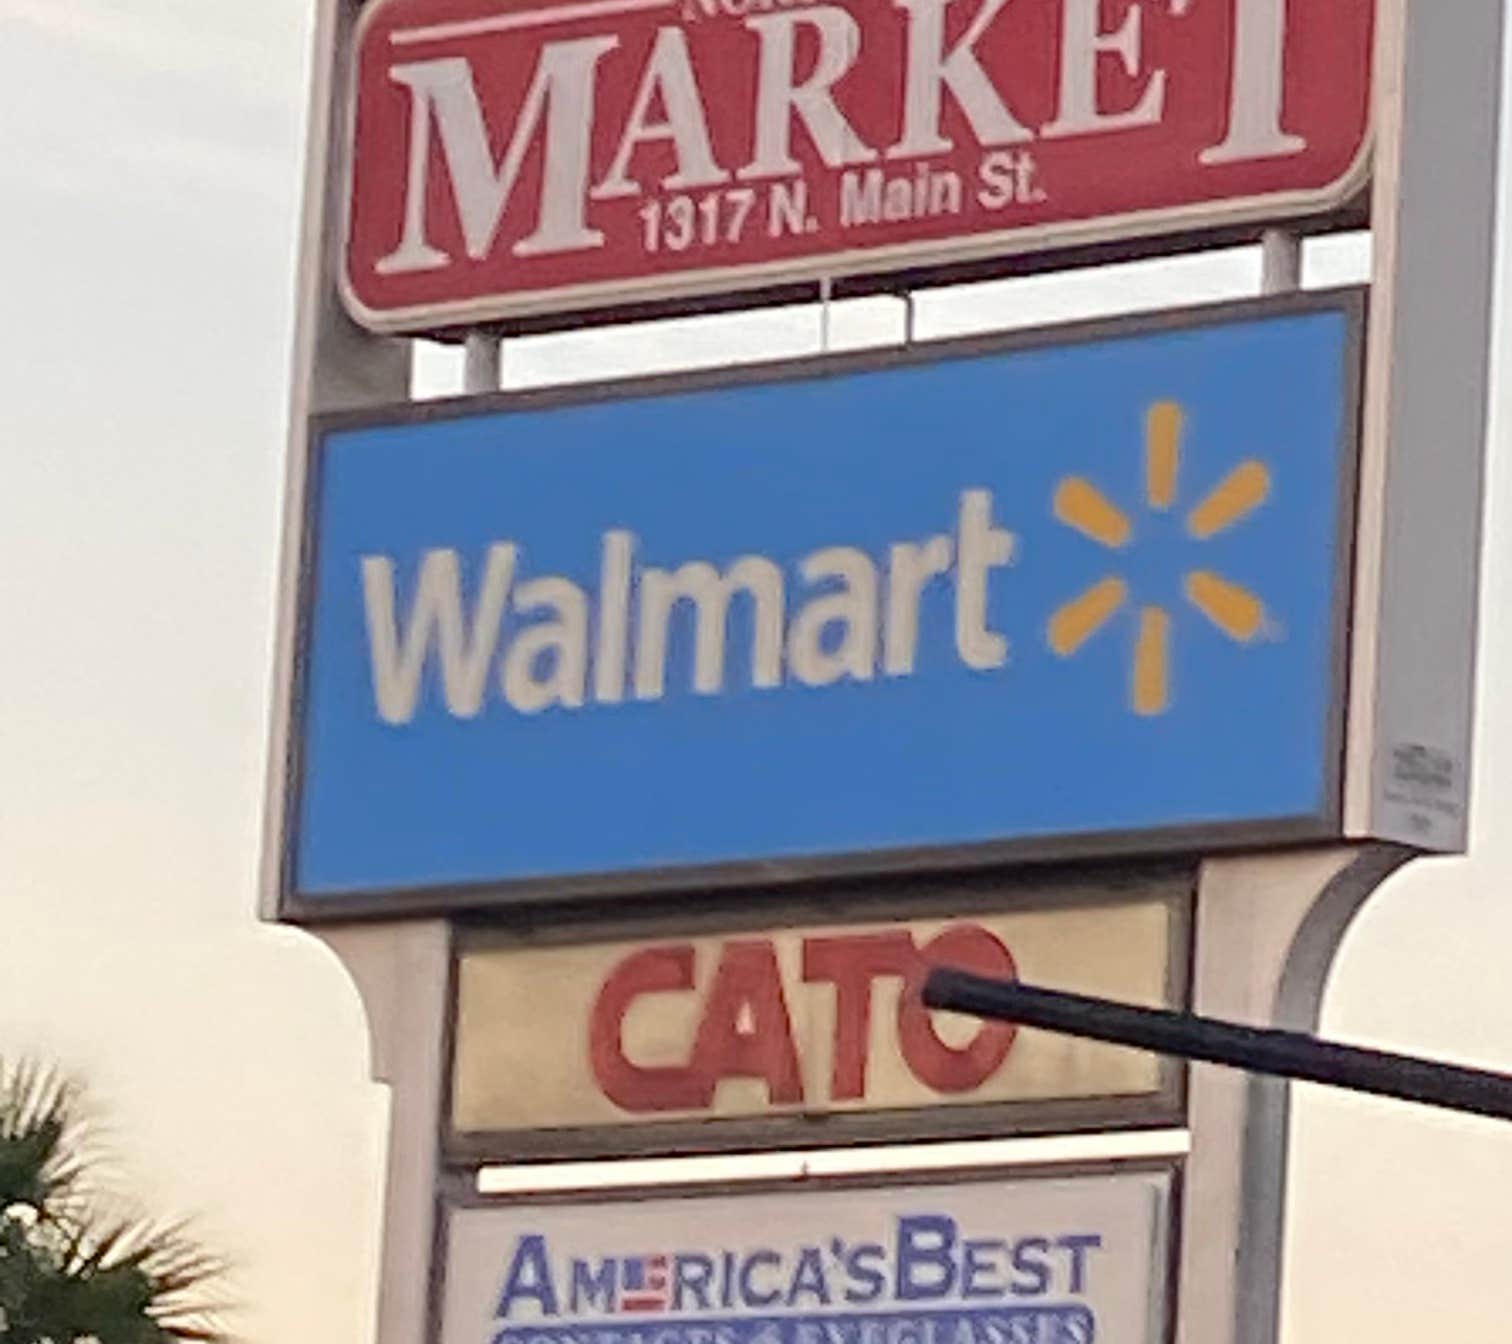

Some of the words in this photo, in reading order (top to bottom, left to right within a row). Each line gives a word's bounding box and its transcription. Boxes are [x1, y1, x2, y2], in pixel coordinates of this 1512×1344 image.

[638, 188, 752, 253] 1317
[767, 189, 819, 236] N.
[839, 163, 962, 225] Main
[977, 147, 1046, 207] St.
[362, 487, 1018, 725] Walmart
[588, 921, 1019, 1114] CATO
[896, 1213, 1102, 1300] BEST
